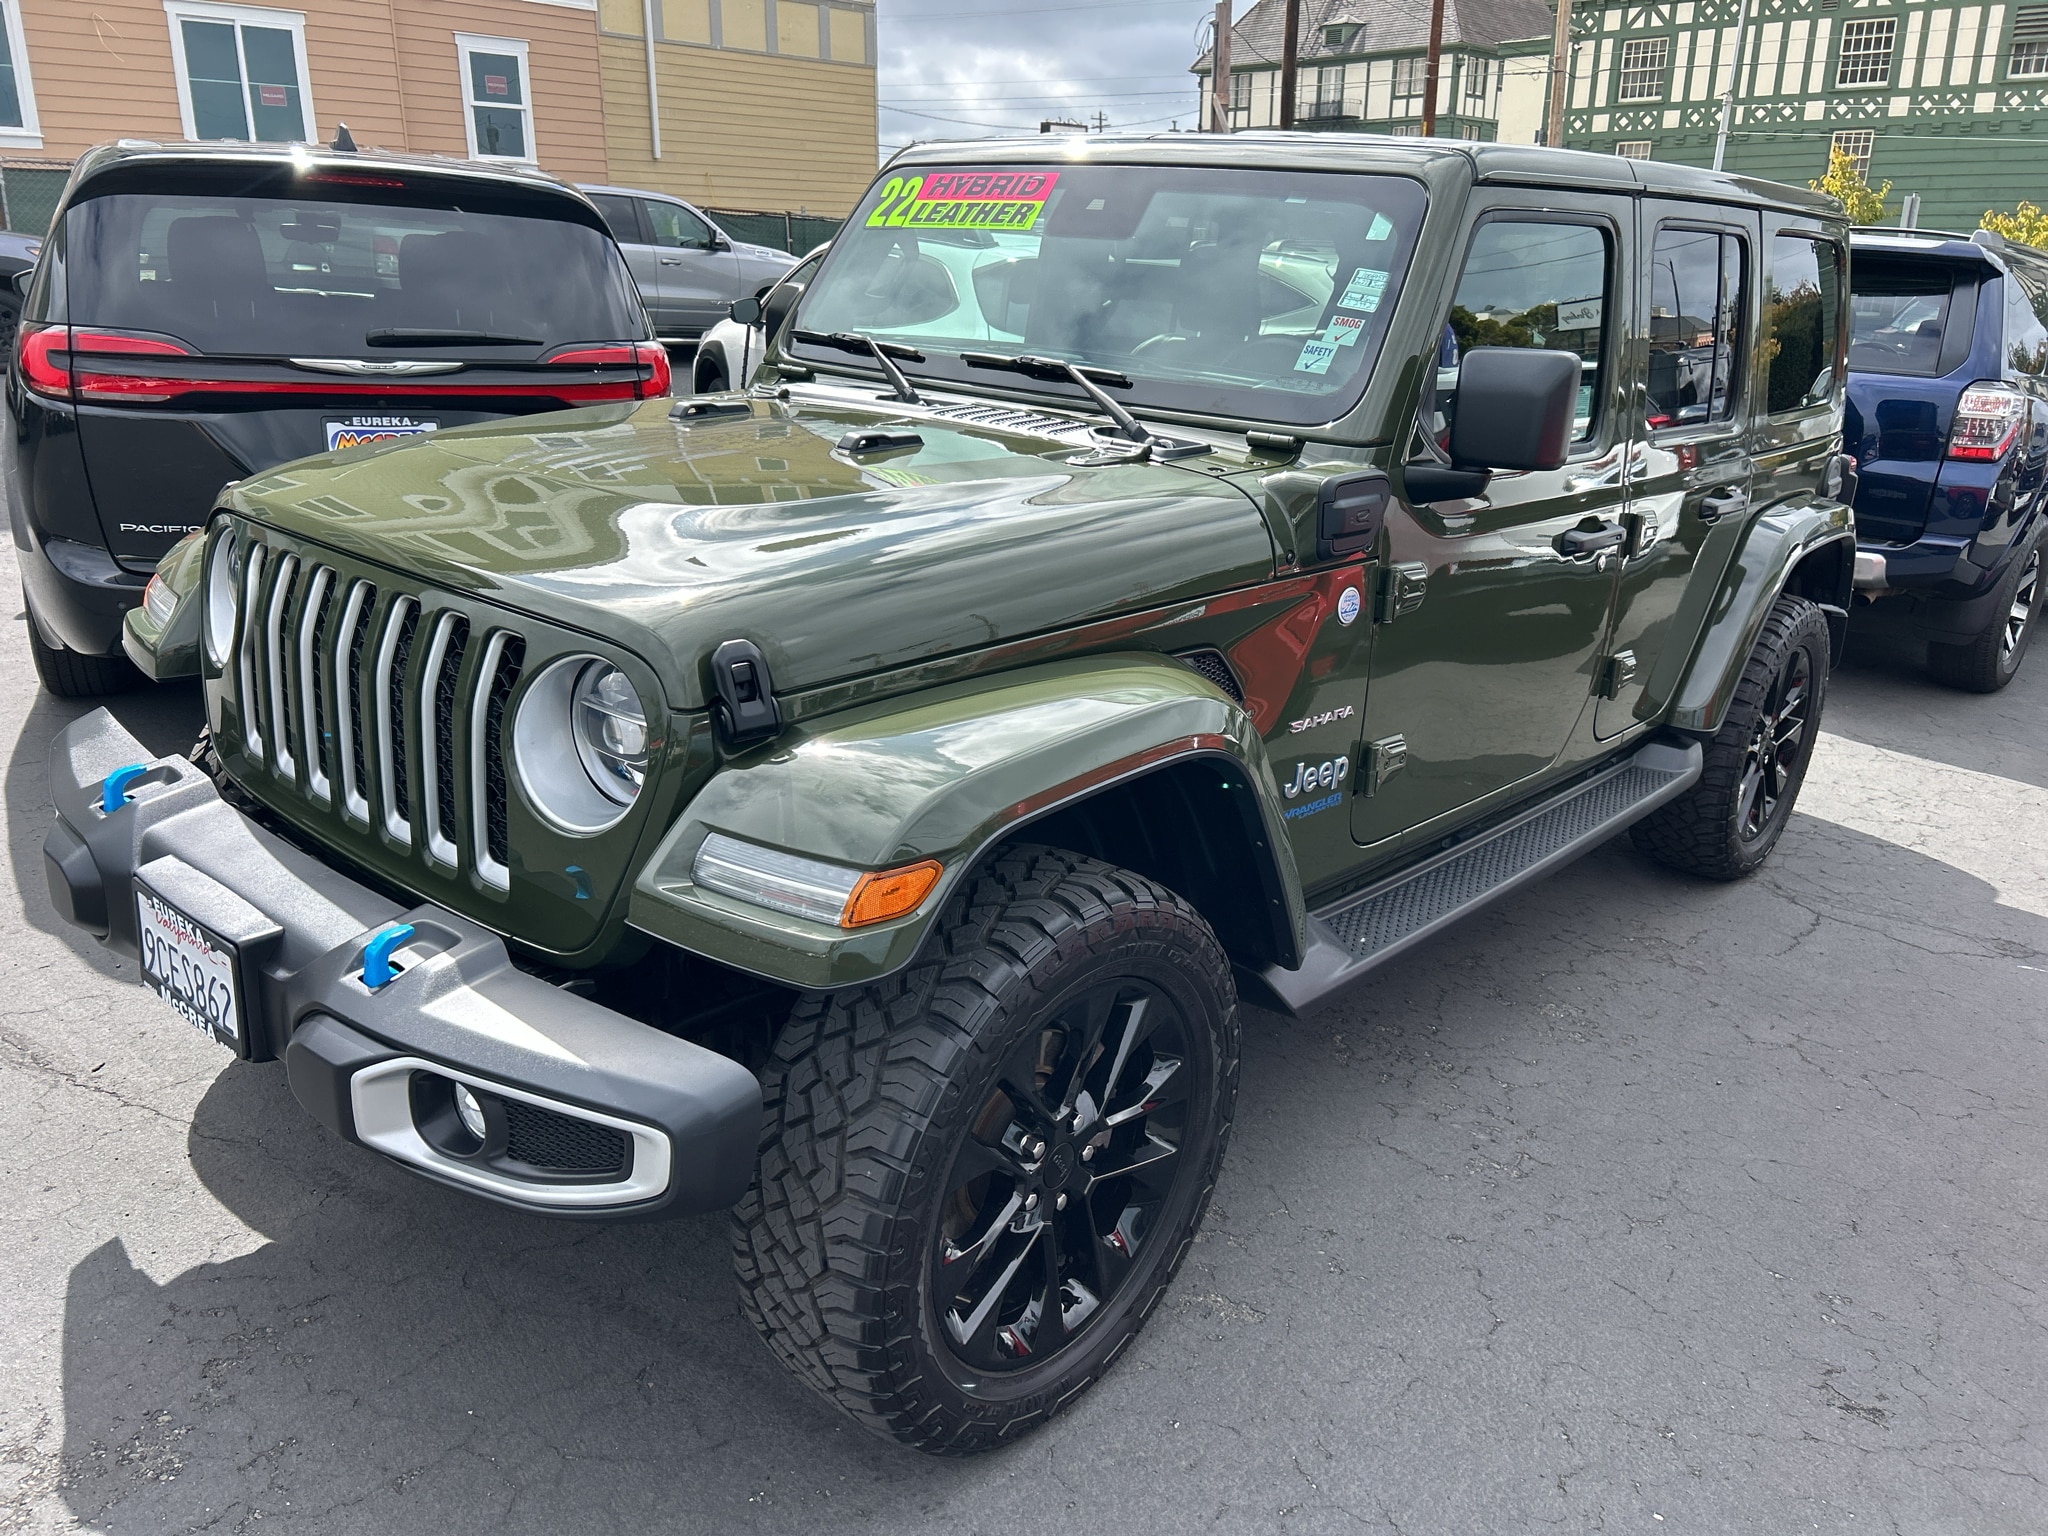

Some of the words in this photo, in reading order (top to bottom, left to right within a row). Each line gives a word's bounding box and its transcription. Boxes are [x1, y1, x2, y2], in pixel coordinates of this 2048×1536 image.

[926, 174, 1048, 199] HYBRID
[865, 176, 924, 229] 22
[908, 202, 1038, 227] LEATHER
[1333, 317, 1362, 329] SMOG
[1303, 345, 1334, 358] SAFETY
[352, 416, 412, 427] EUREKA
[1289, 705, 1355, 734] SAHARA
[1283, 755, 1349, 799] Jeep
[1283, 792, 1342, 820] WRANGLER
[152, 896, 206, 948] EUREKA
[145, 927, 235, 1037] 9CES862
[160, 985, 217, 1044] McCREA
